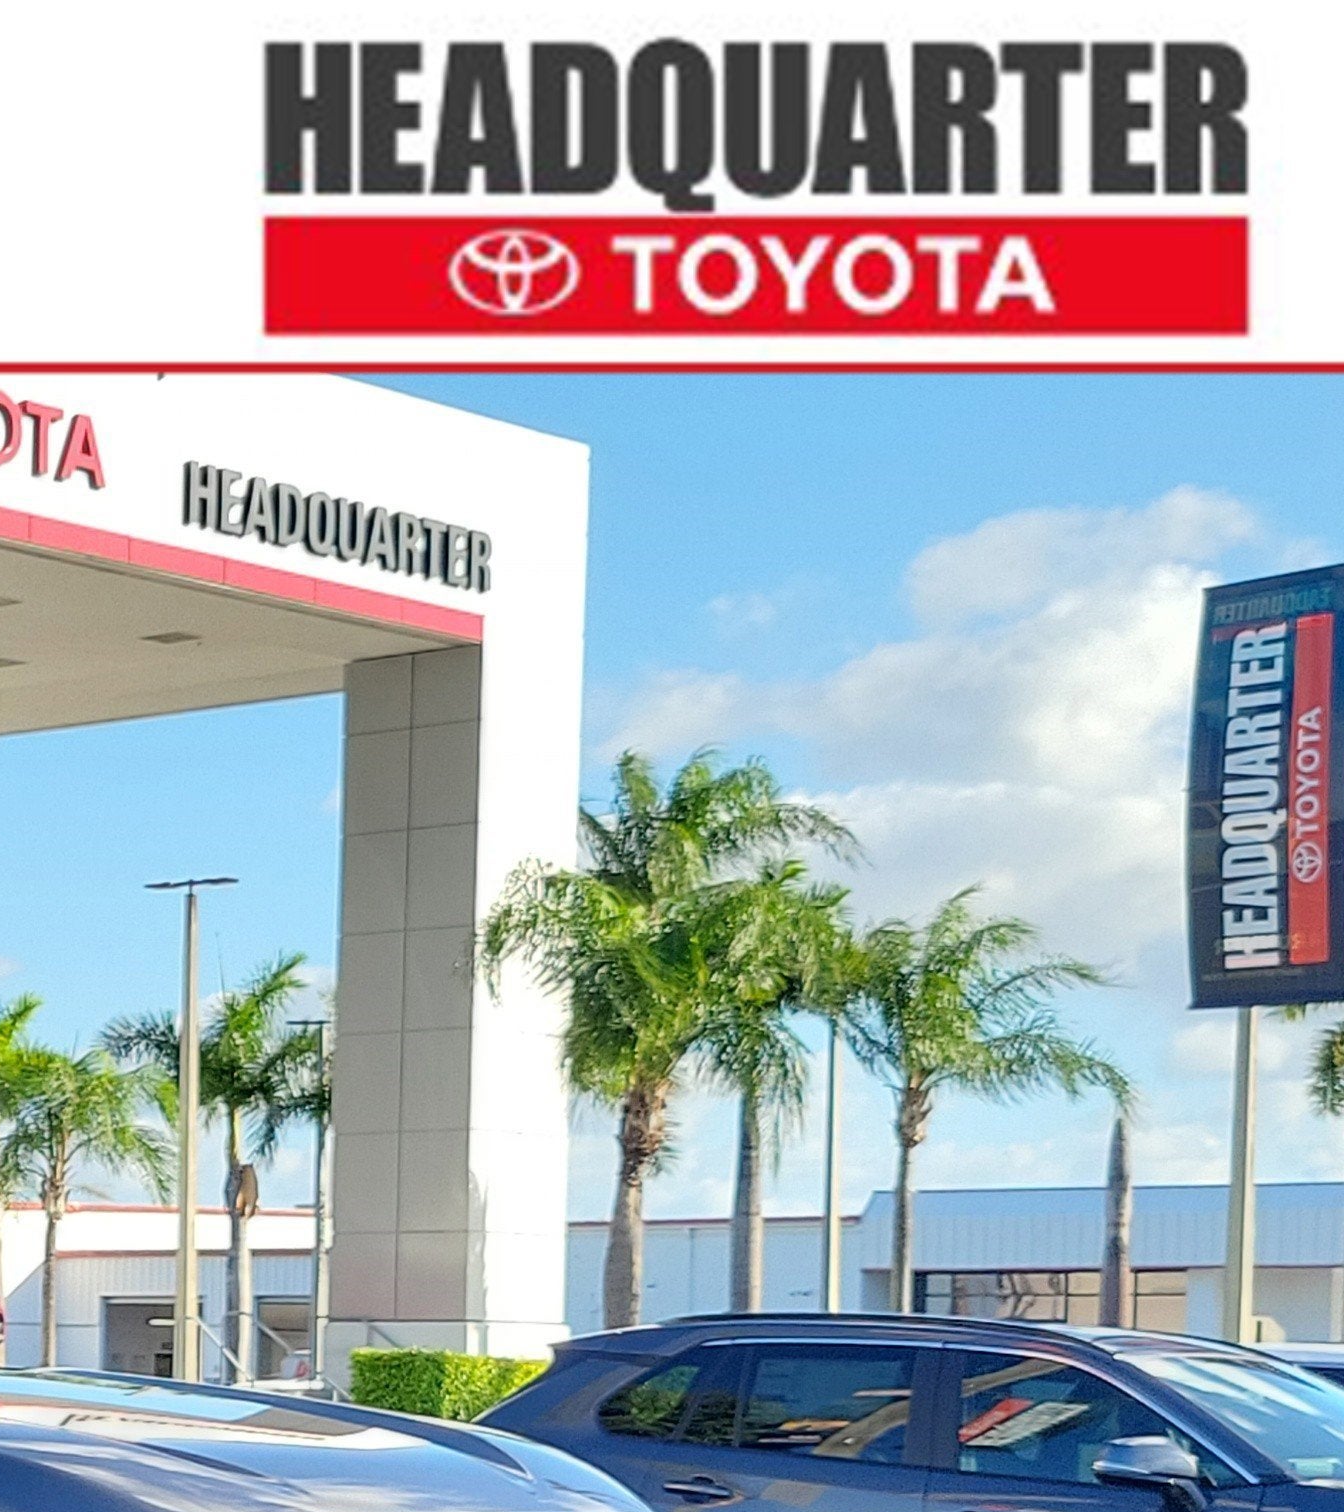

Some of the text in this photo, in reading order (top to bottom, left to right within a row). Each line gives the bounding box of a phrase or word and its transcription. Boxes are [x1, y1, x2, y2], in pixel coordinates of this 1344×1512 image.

[182, 460, 492, 593] HEADQUARTER
[1221, 620, 1287, 971] HEADQUARTER
[1295, 706, 1323, 838] TOYOTA
